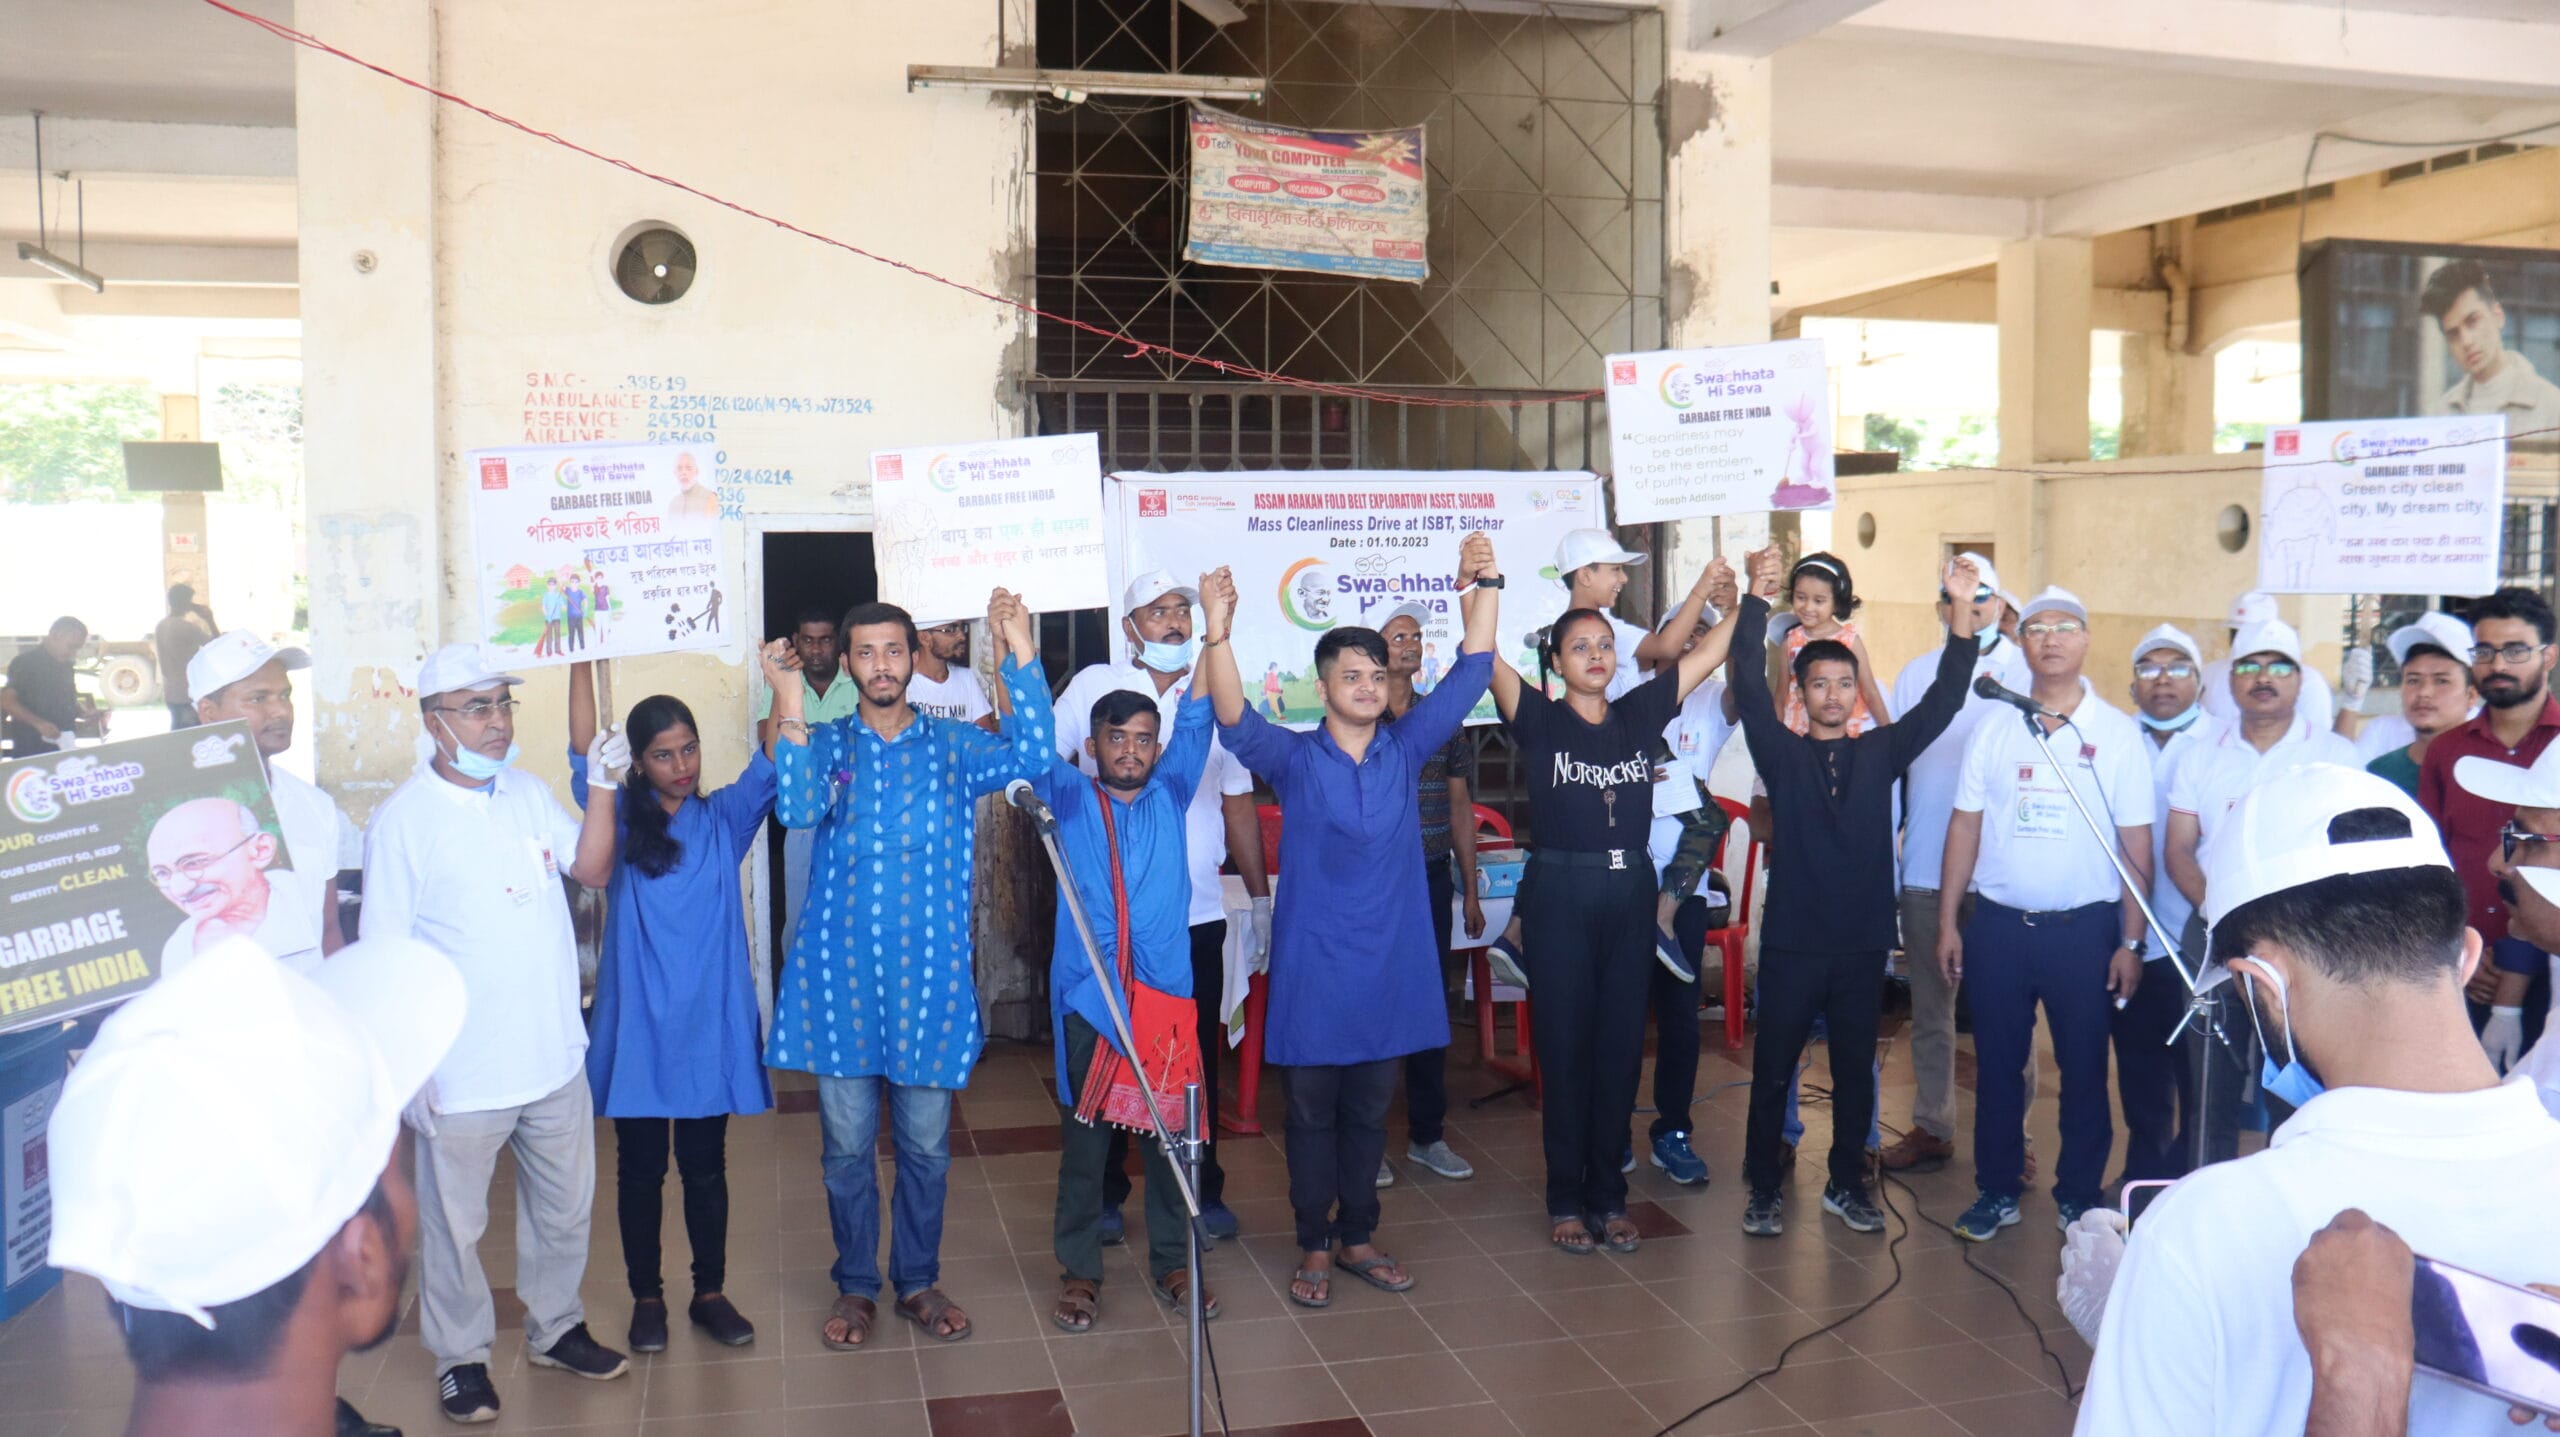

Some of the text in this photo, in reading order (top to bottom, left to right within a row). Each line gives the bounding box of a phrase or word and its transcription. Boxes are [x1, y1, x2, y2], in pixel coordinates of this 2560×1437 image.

[1211, 138, 1231, 149] Tech
[1272, 150, 1346, 167] COMPUTER
[1235, 180, 1271, 190] COMPUTER
[1287, 184, 1327, 196] VOCATIONAL
[1694, 369, 1775, 385] Swachhata
[1708, 383, 1762, 397] Hi Seva
[647, 413, 717, 428] 245801
[1679, 406, 1771, 424] GARBAGE FREE INDIA
[1714, 427, 1744, 441] may
[1652, 443, 1728, 458] be defined
[2361, 437, 2429, 449] Swachhata
[582, 462, 645, 476] Swachhata
[959, 456, 1031, 472] Swachhata
[1630, 455, 1753, 475] to be the emblem
[2364, 463, 2466, 477] GARBAGE FREE INDIA
[970, 470, 1020, 481] Hi Seva
[1635, 479, 1649, 490] of
[1652, 474, 1690, 490] purity
[1694, 473, 1708, 485] of
[2342, 480, 2464, 497] Green city clean
[550, 490, 652, 511] GARBAGE FREE INDIA
[959, 489, 1056, 508] GARBAGE FREE INDIA
[1254, 492, 1495, 510] ASSAM ARAKAN FOLD BELT EXPLORATORY ASSET, SILCHAR
[1653, 491, 1726, 507] Joseph Addison
[2376, 502, 2399, 516] My
[2402, 500, 2450, 514] dream
[2455, 500, 2488, 516] city.
[527, 511, 660, 544] পরিচ্ছন্নতাই পরিচয়
[1248, 514, 1504, 533] Mass Cleanliness Drive at ISBT, Silchar
[974, 526, 992, 541] का
[1330, 537, 1357, 548] Date
[1366, 536, 1429, 548] 01.10.2023
[1337, 573, 1457, 594] Swachhat
[1426, 629, 1448, 638] India
[49, 763, 142, 792] Swachhata
[68, 781, 131, 803] Hi Seva
[37, 826, 88, 845] COUNTRY
[88, 824, 99, 834] IS
[26, 854, 73, 874] IDENTITY
[74, 851, 94, 863] SO,
[94, 844, 122, 858] KEEP
[10, 863, 129, 904] IDENTITY CLEAN.
[0, 908, 128, 970] GARBAGE
[0, 949, 150, 1016] FREE INDIA
